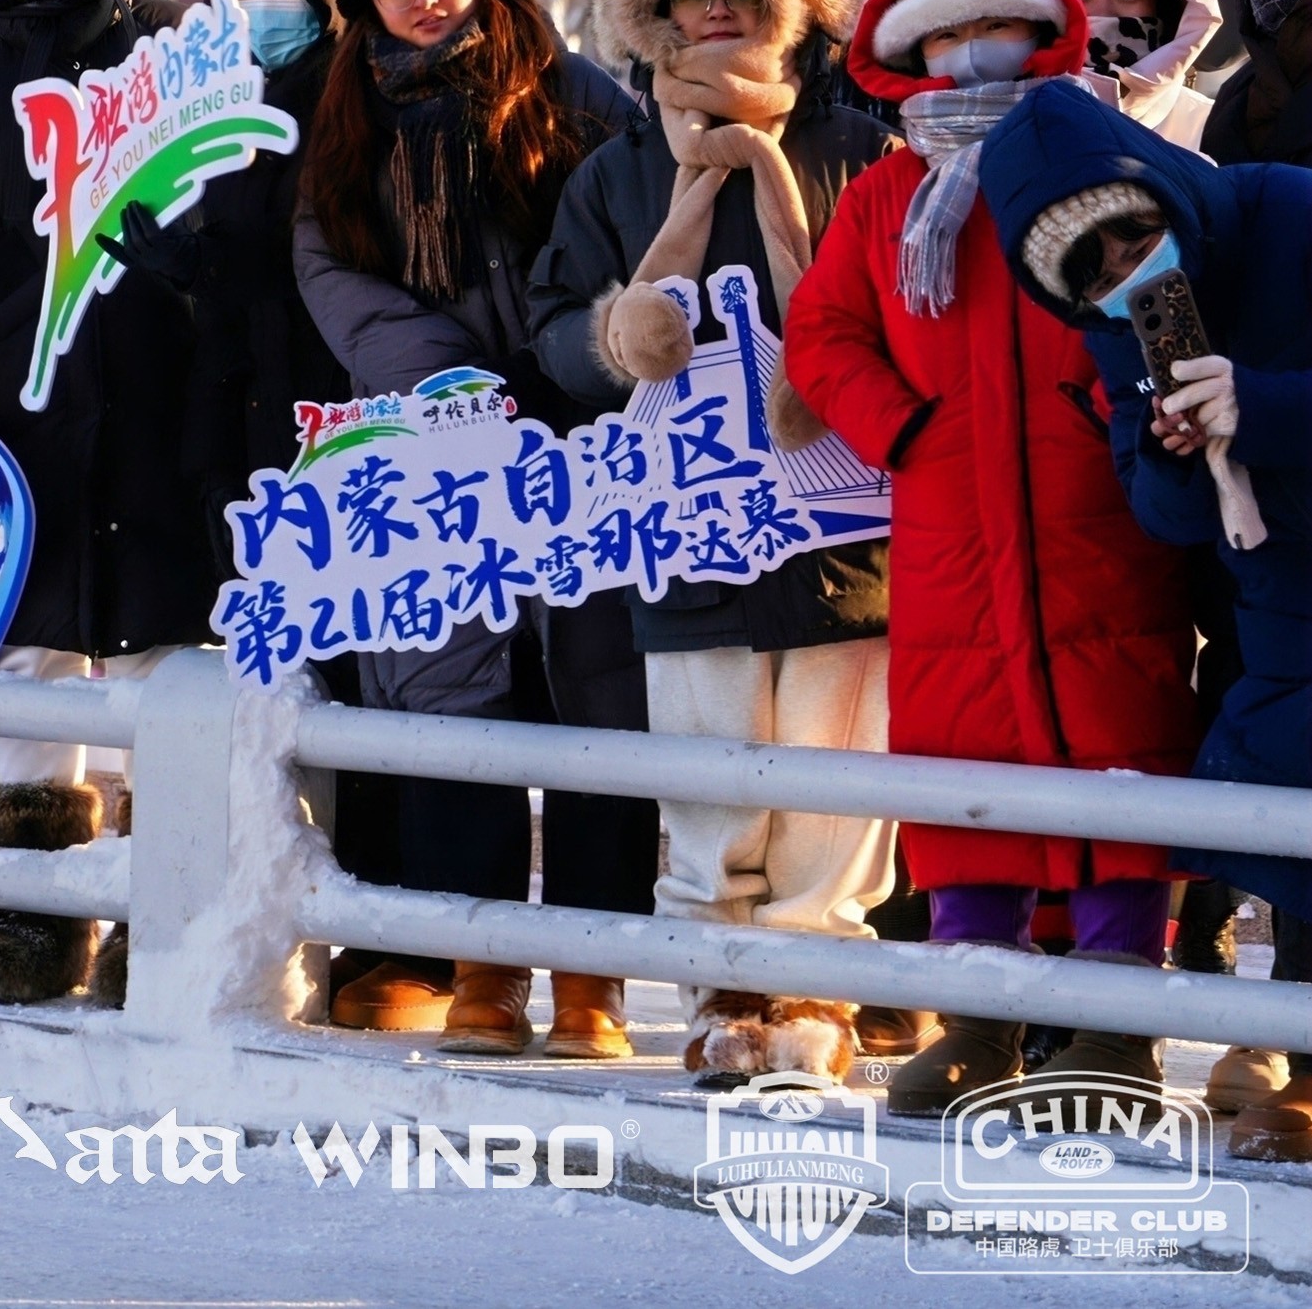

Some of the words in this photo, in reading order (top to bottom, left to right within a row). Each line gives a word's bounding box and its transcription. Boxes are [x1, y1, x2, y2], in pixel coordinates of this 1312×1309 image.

[90, 176, 110, 209] GE
[112, 140, 143, 180] YOU
[148, 115, 175, 150] NEI
[179, 91, 226, 128] MENG
[230, 80, 253, 104] GU
[323, 396, 403, 433] 歌游内蒙古
[336, 425, 354, 436] YOU
[354, 421, 369, 430] NEI
[369, 418, 393, 427] MENG
[393, 417, 406, 425] GU
[423, 393, 504, 425] 呼伦贝尔
[428, 412, 501, 434] HULUNBUIR
[236, 395, 765, 571] 内蒙古自治区
[221, 480, 811, 685] 第21届冰雪那达慕
